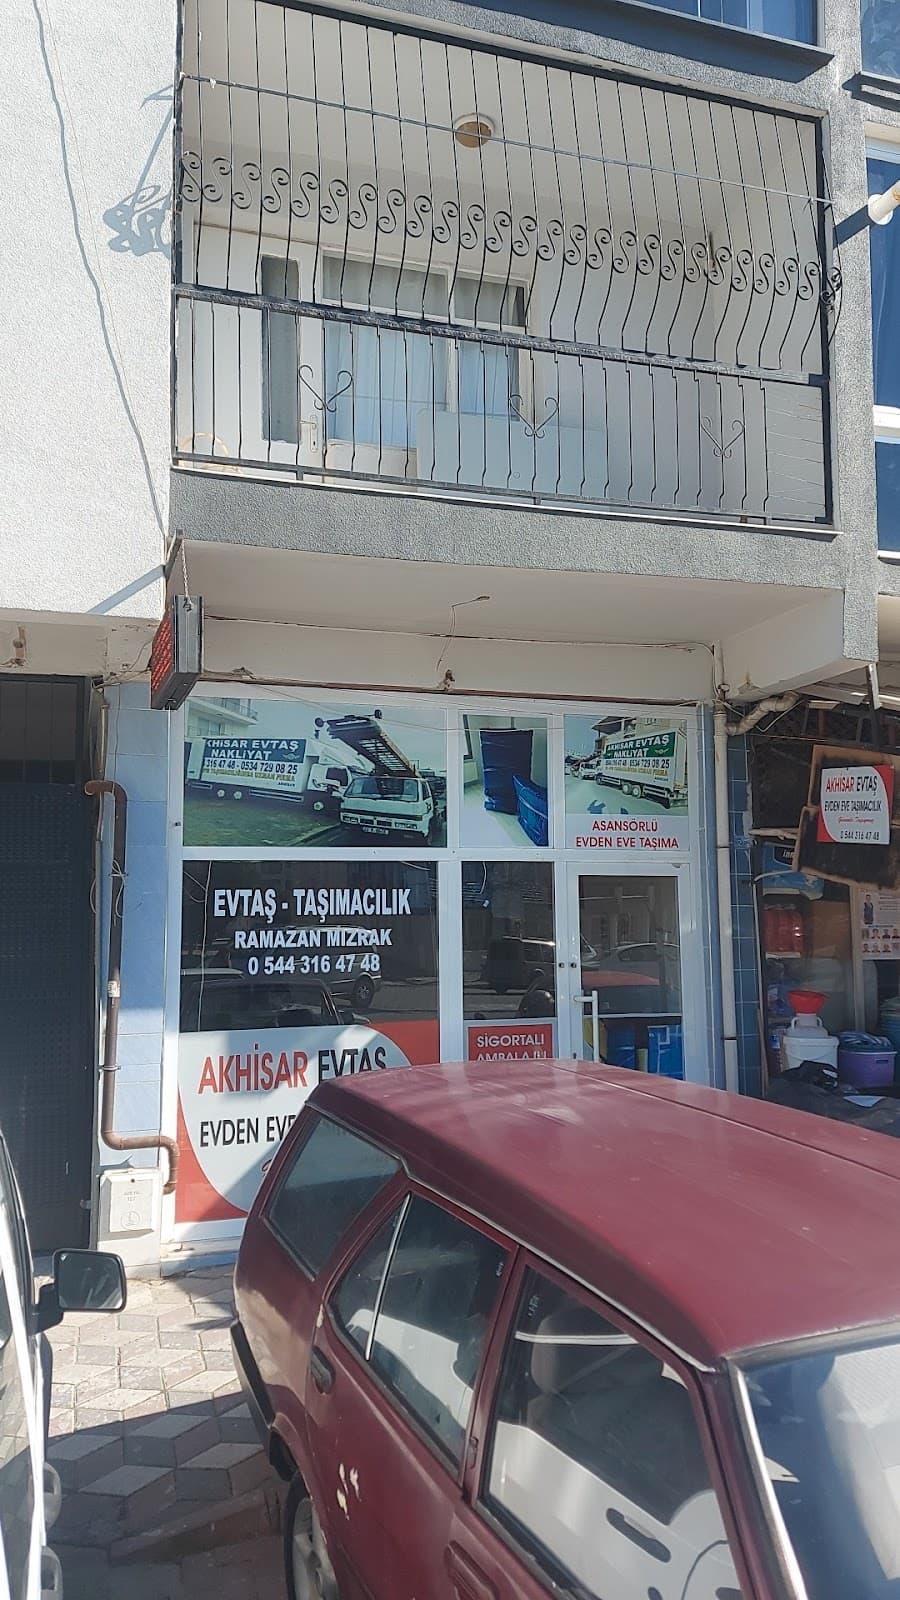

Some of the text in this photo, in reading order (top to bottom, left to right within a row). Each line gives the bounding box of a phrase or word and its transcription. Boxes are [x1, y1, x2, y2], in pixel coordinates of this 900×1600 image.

[252, 740, 299, 752] EVTAŞ
[635, 735, 670, 746] EVTAŞ
[211, 749, 272, 760] NAKLİYAT
[241, 761, 258, 771] 0534
[260, 763, 273, 773] 729
[275, 763, 286, 773] 08
[288, 764, 298, 774] 25
[661, 759, 670, 768] 25
[856, 775, 878, 796] EVTAŞ
[592, 818, 658, 831] ASANSÖRLÜ
[576, 837, 679, 850] EVDEN EVE TAŞIMA
[214, 888, 276, 923] EVTAŞ
[293, 888, 411, 922] TAŞIMACILIK
[235, 928, 392, 949] RAMAZAN MIZRAK
[248, 954, 380, 975] 0 544 316 47 48
[477, 1033, 545, 1048] SİGORTALI
[198, 1043, 308, 1094] AKHİSAR
[200, 1117, 259, 1148] EVDEN
